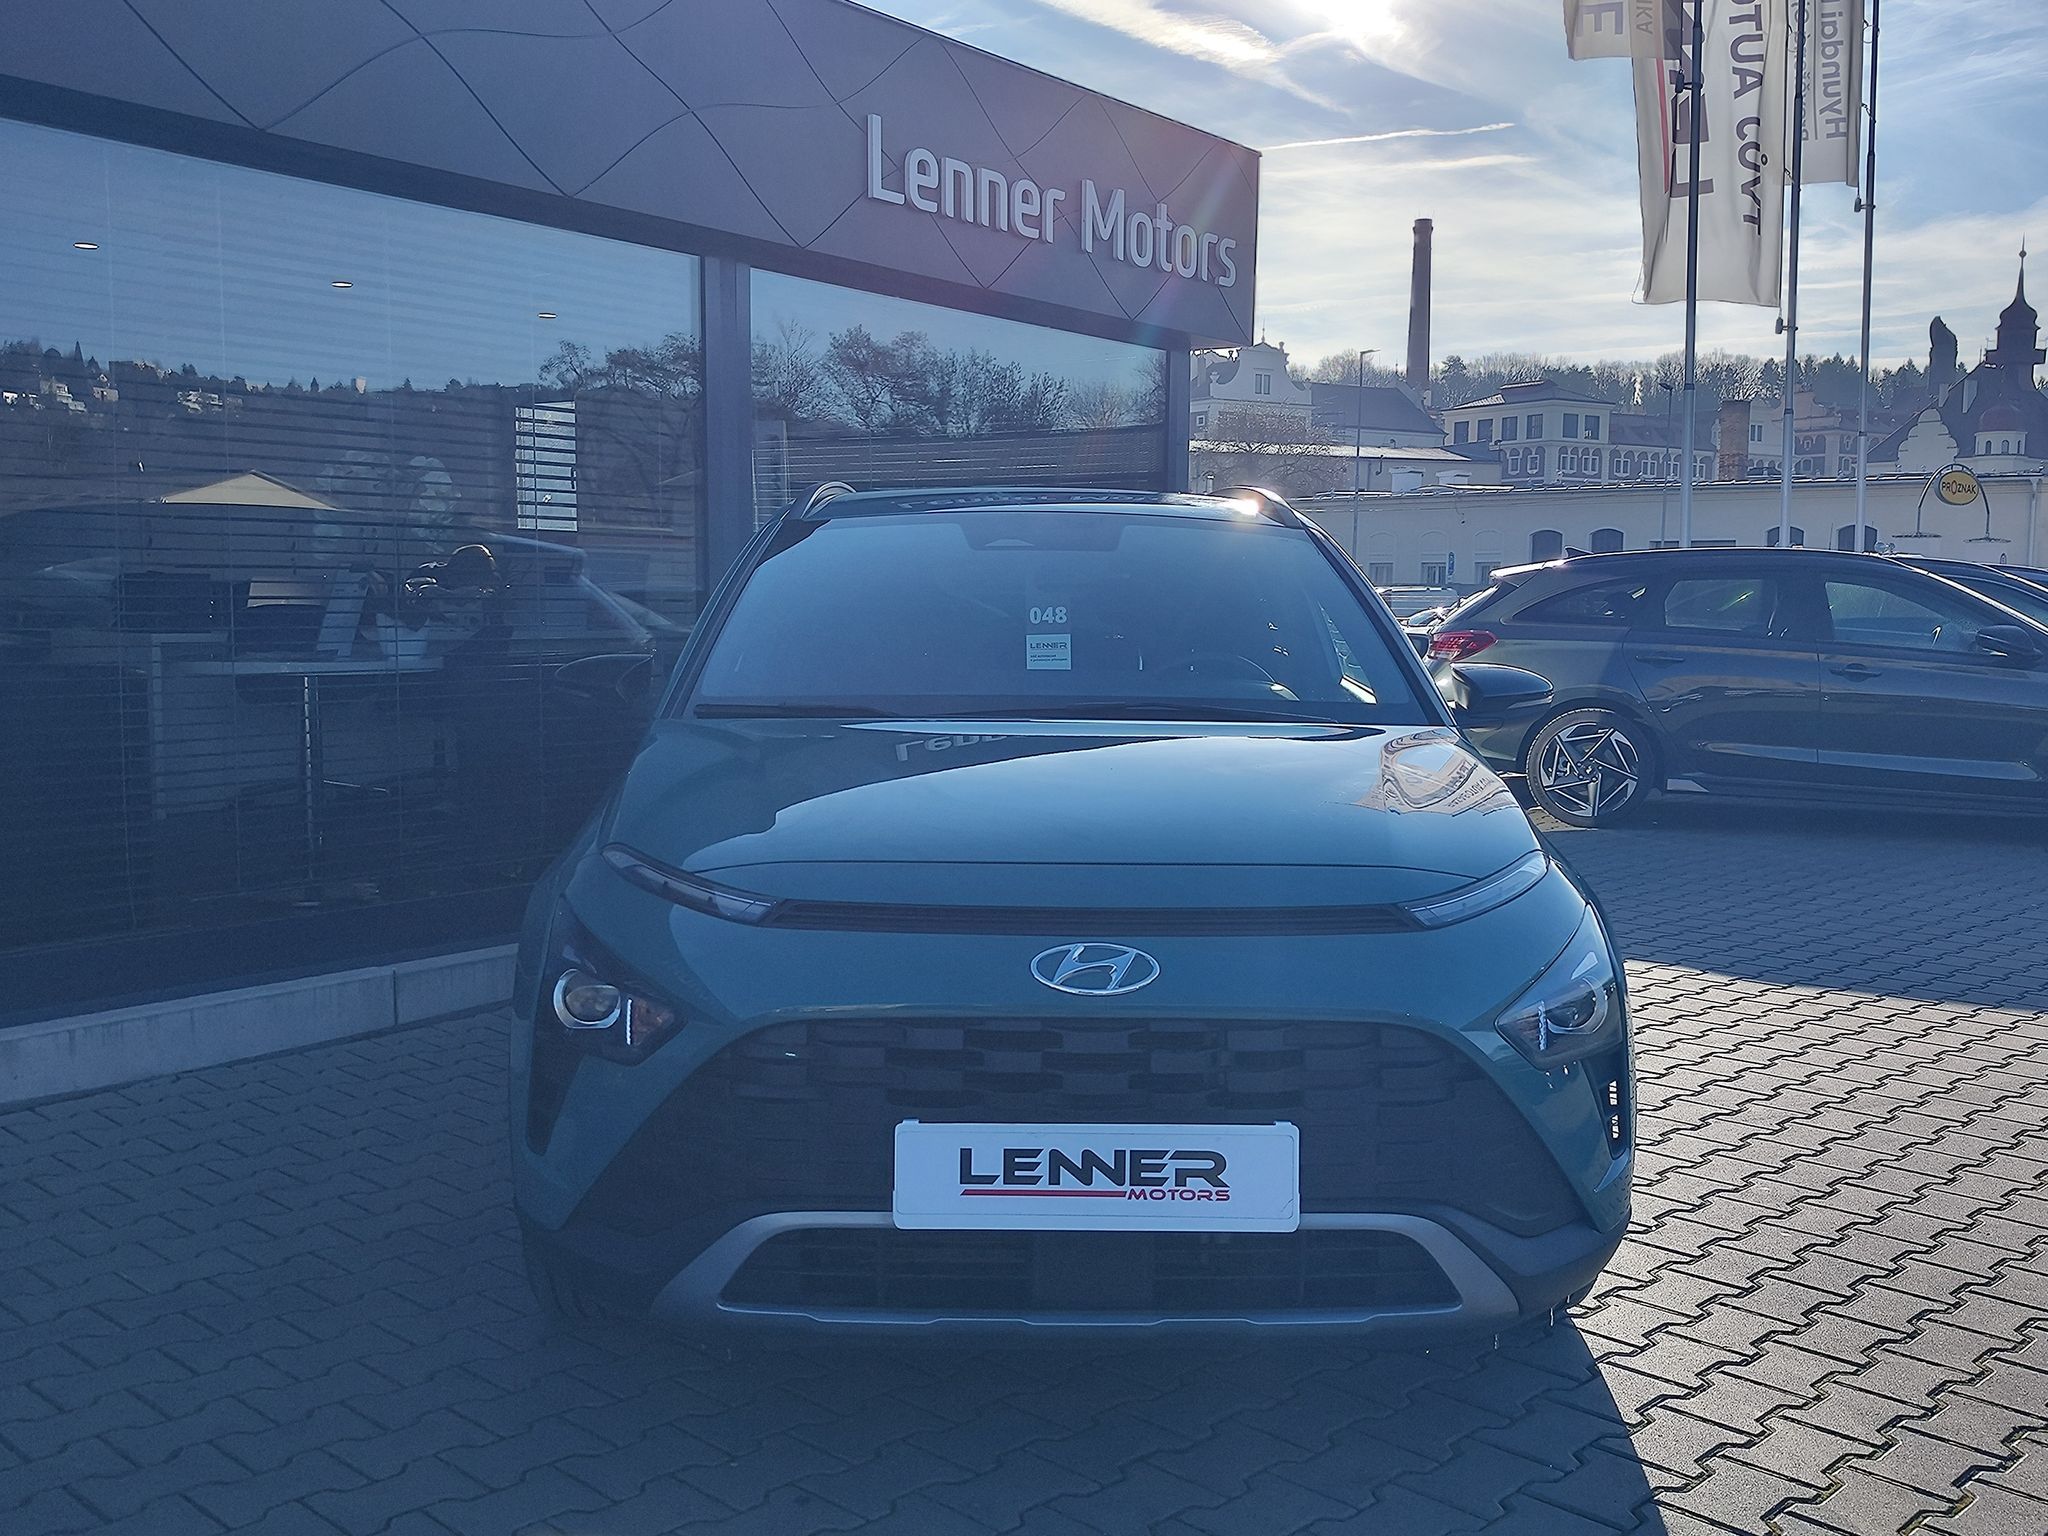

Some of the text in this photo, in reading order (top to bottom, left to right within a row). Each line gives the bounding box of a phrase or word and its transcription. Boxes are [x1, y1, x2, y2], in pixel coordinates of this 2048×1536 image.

[867, 113, 1237, 288] Lenner Motors
[1029, 606, 1068, 624] 048
[1030, 641, 1068, 649] LENNER
[959, 1147, 1231, 1187] LENNER
[1127, 1189, 1231, 1201] MOTORS
